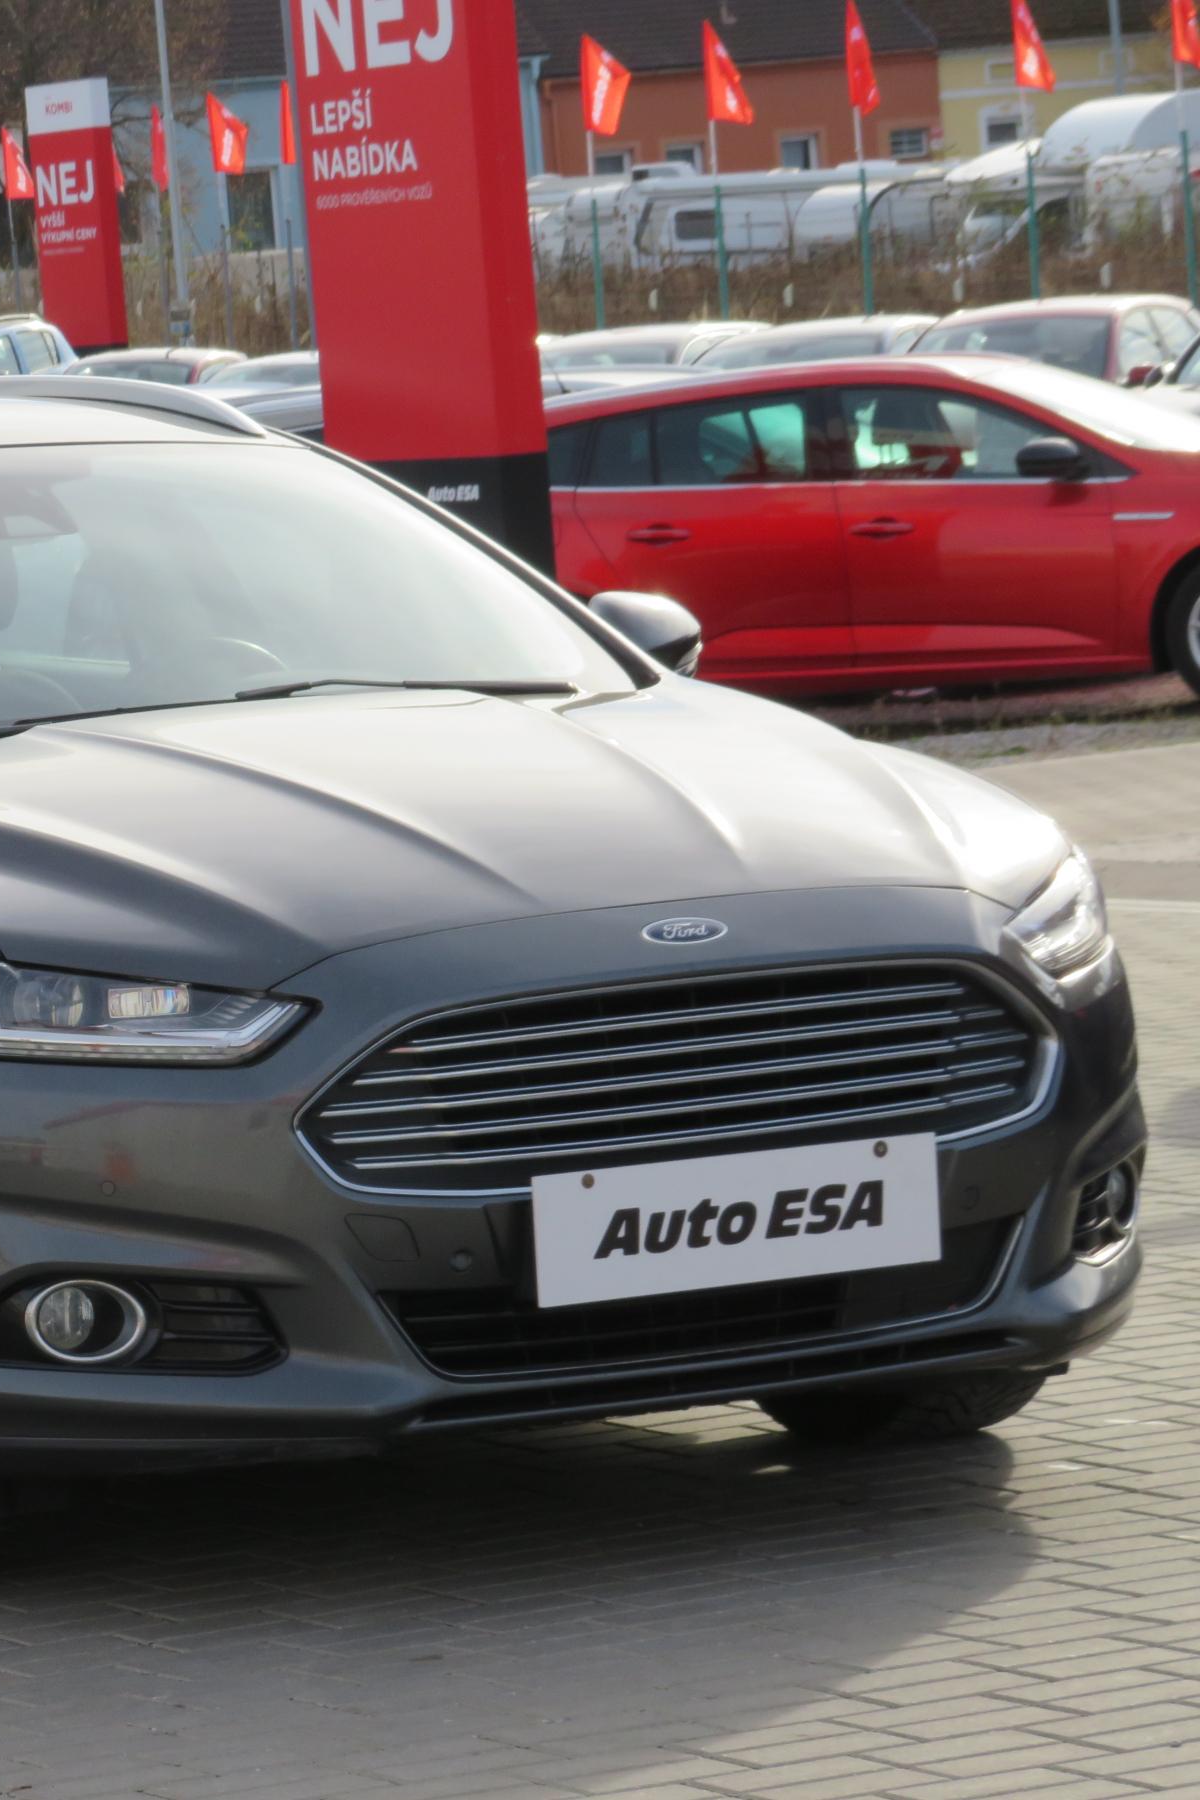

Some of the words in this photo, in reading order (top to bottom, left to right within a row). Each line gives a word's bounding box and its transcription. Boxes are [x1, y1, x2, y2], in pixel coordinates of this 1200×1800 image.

[301, 0, 454, 78] NEJ
[310, 88, 372, 135] LEPŠÍ
[312, 137, 418, 181] NABÍDKA
[35, 159, 95, 208] NEJ
[427, 486, 456, 502] Auto
[456, 484, 480, 501] ESA
[662, 922, 709, 939] Ford
[593, 1198, 757, 1260] Auto
[764, 1180, 885, 1239] ESA
